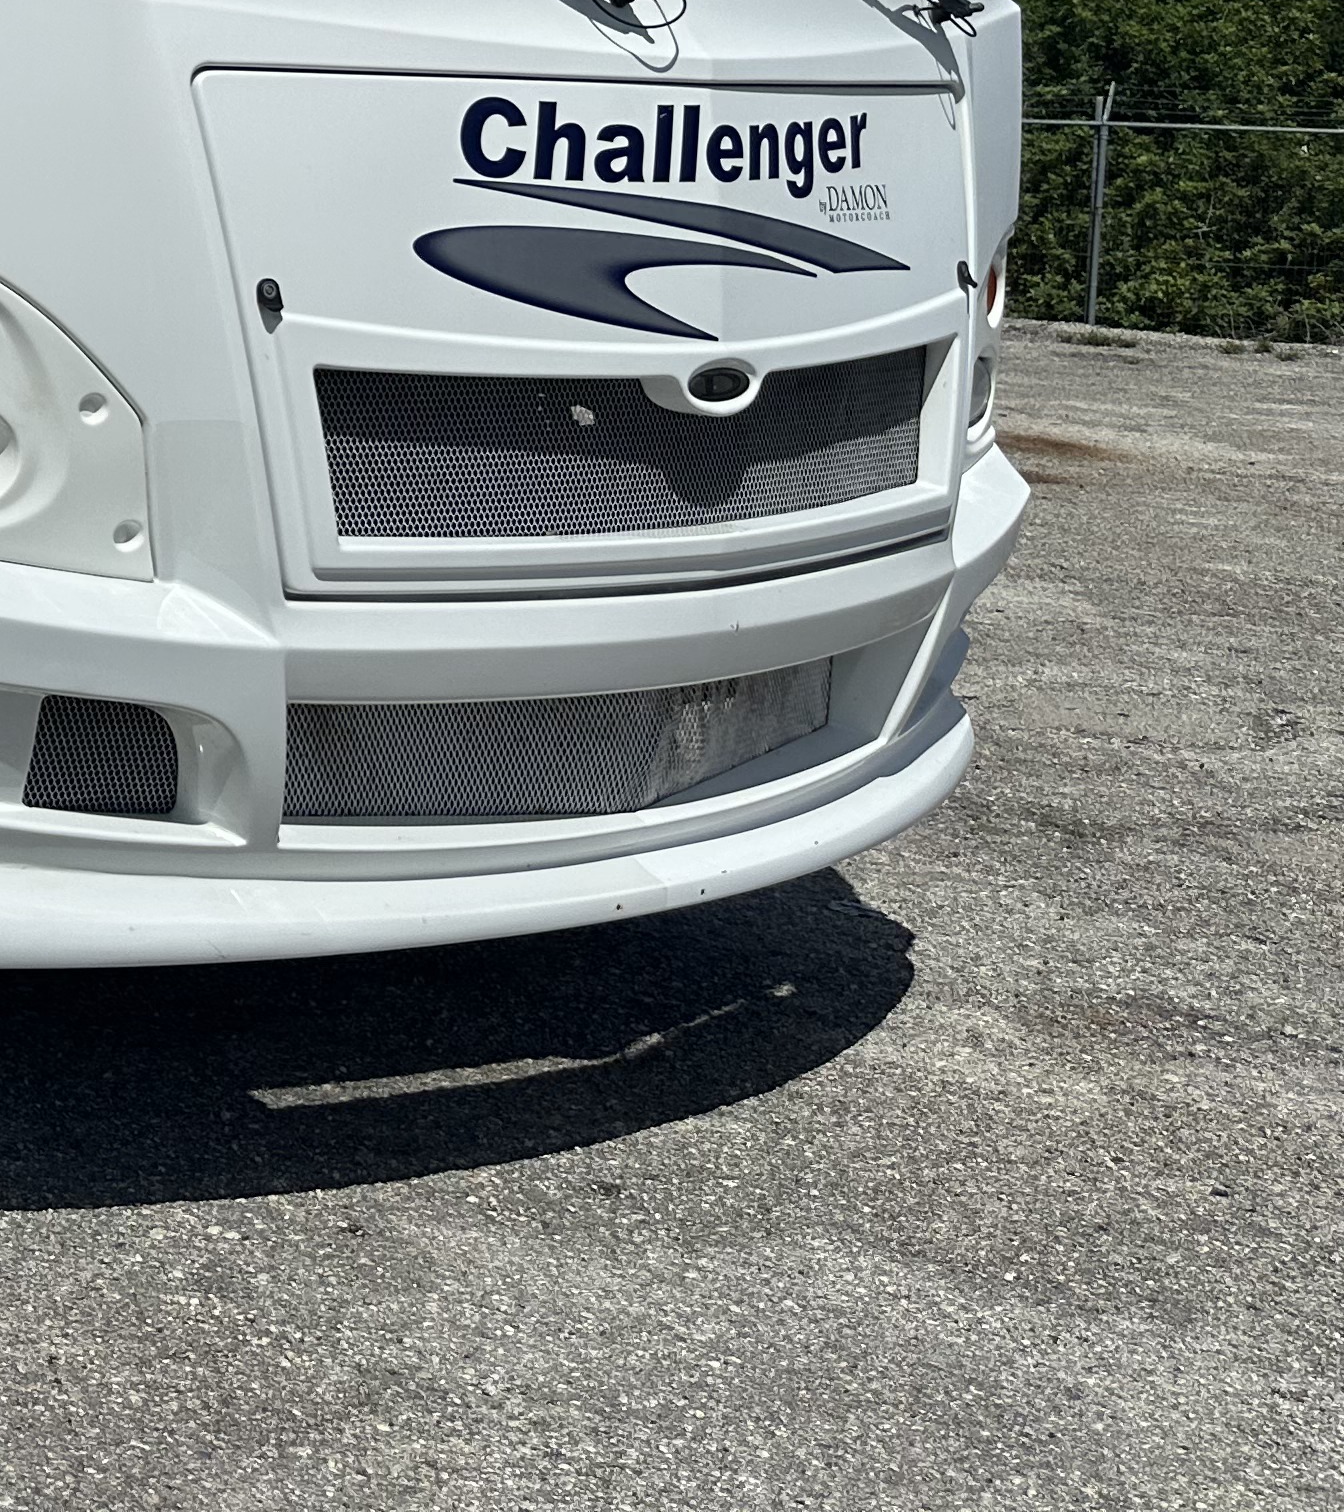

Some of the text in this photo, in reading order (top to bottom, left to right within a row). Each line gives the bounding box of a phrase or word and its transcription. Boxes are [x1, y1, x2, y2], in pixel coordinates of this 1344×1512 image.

[459, 96, 868, 199] Challenger
[826, 184, 889, 212] DAMON
[829, 211, 891, 223] MOTORCOACH
